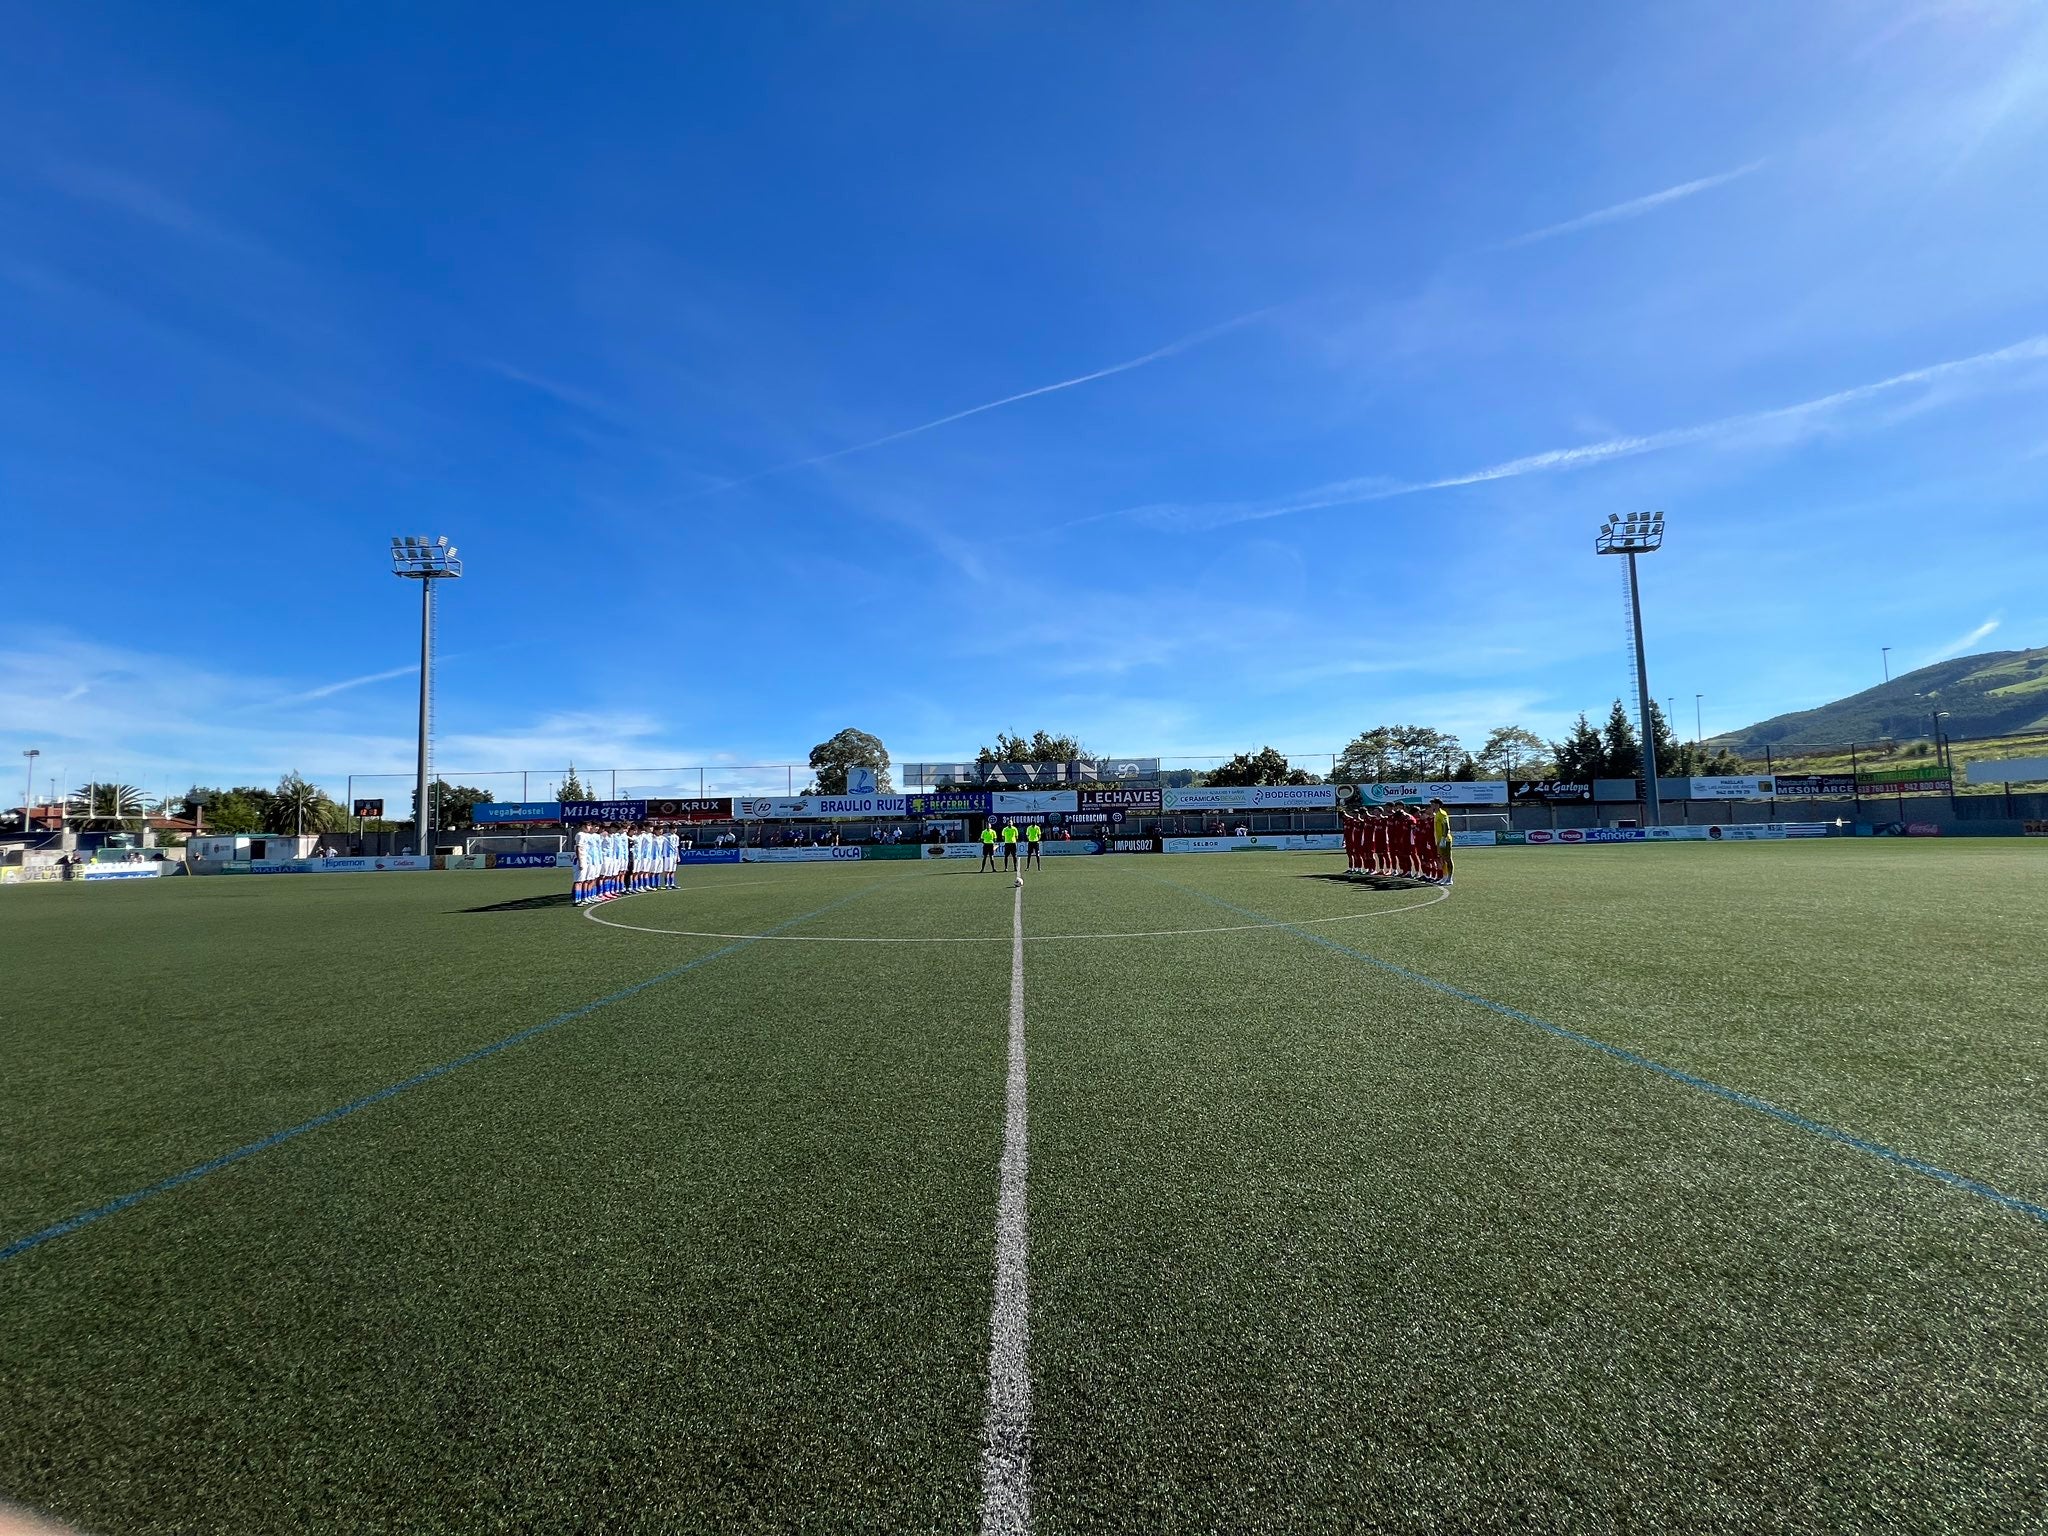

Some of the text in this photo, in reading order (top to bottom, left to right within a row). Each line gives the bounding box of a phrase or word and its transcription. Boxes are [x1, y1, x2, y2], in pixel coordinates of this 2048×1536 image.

[954, 763, 1098, 783] LAVIN
[1383, 784, 1417, 796] San José
[1533, 781, 1550, 792] La
[1777, 785, 1854, 794] MESON ARCE
[1904, 782, 1918, 791] 942
[1082, 792, 1092, 803] J.
[1095, 791, 1160, 803] ECHAVES
[1265, 790, 1332, 799] BODEGOTRANS
[681, 801, 719, 811] KRUX
[757, 803, 772, 812] HD
[820, 799, 905, 812] BRAULIO RUIZ
[930, 800, 971, 811] BECERRIL
[563, 805, 636, 819] Milagros
[1072, 813, 1107, 822] FEDERACIÓN
[1114, 839, 1153, 851] IMPULSO27
[681, 849, 737, 857] VITALDENT
[832, 847, 860, 858] CUCA
[506, 856, 541, 865] LAVIN
